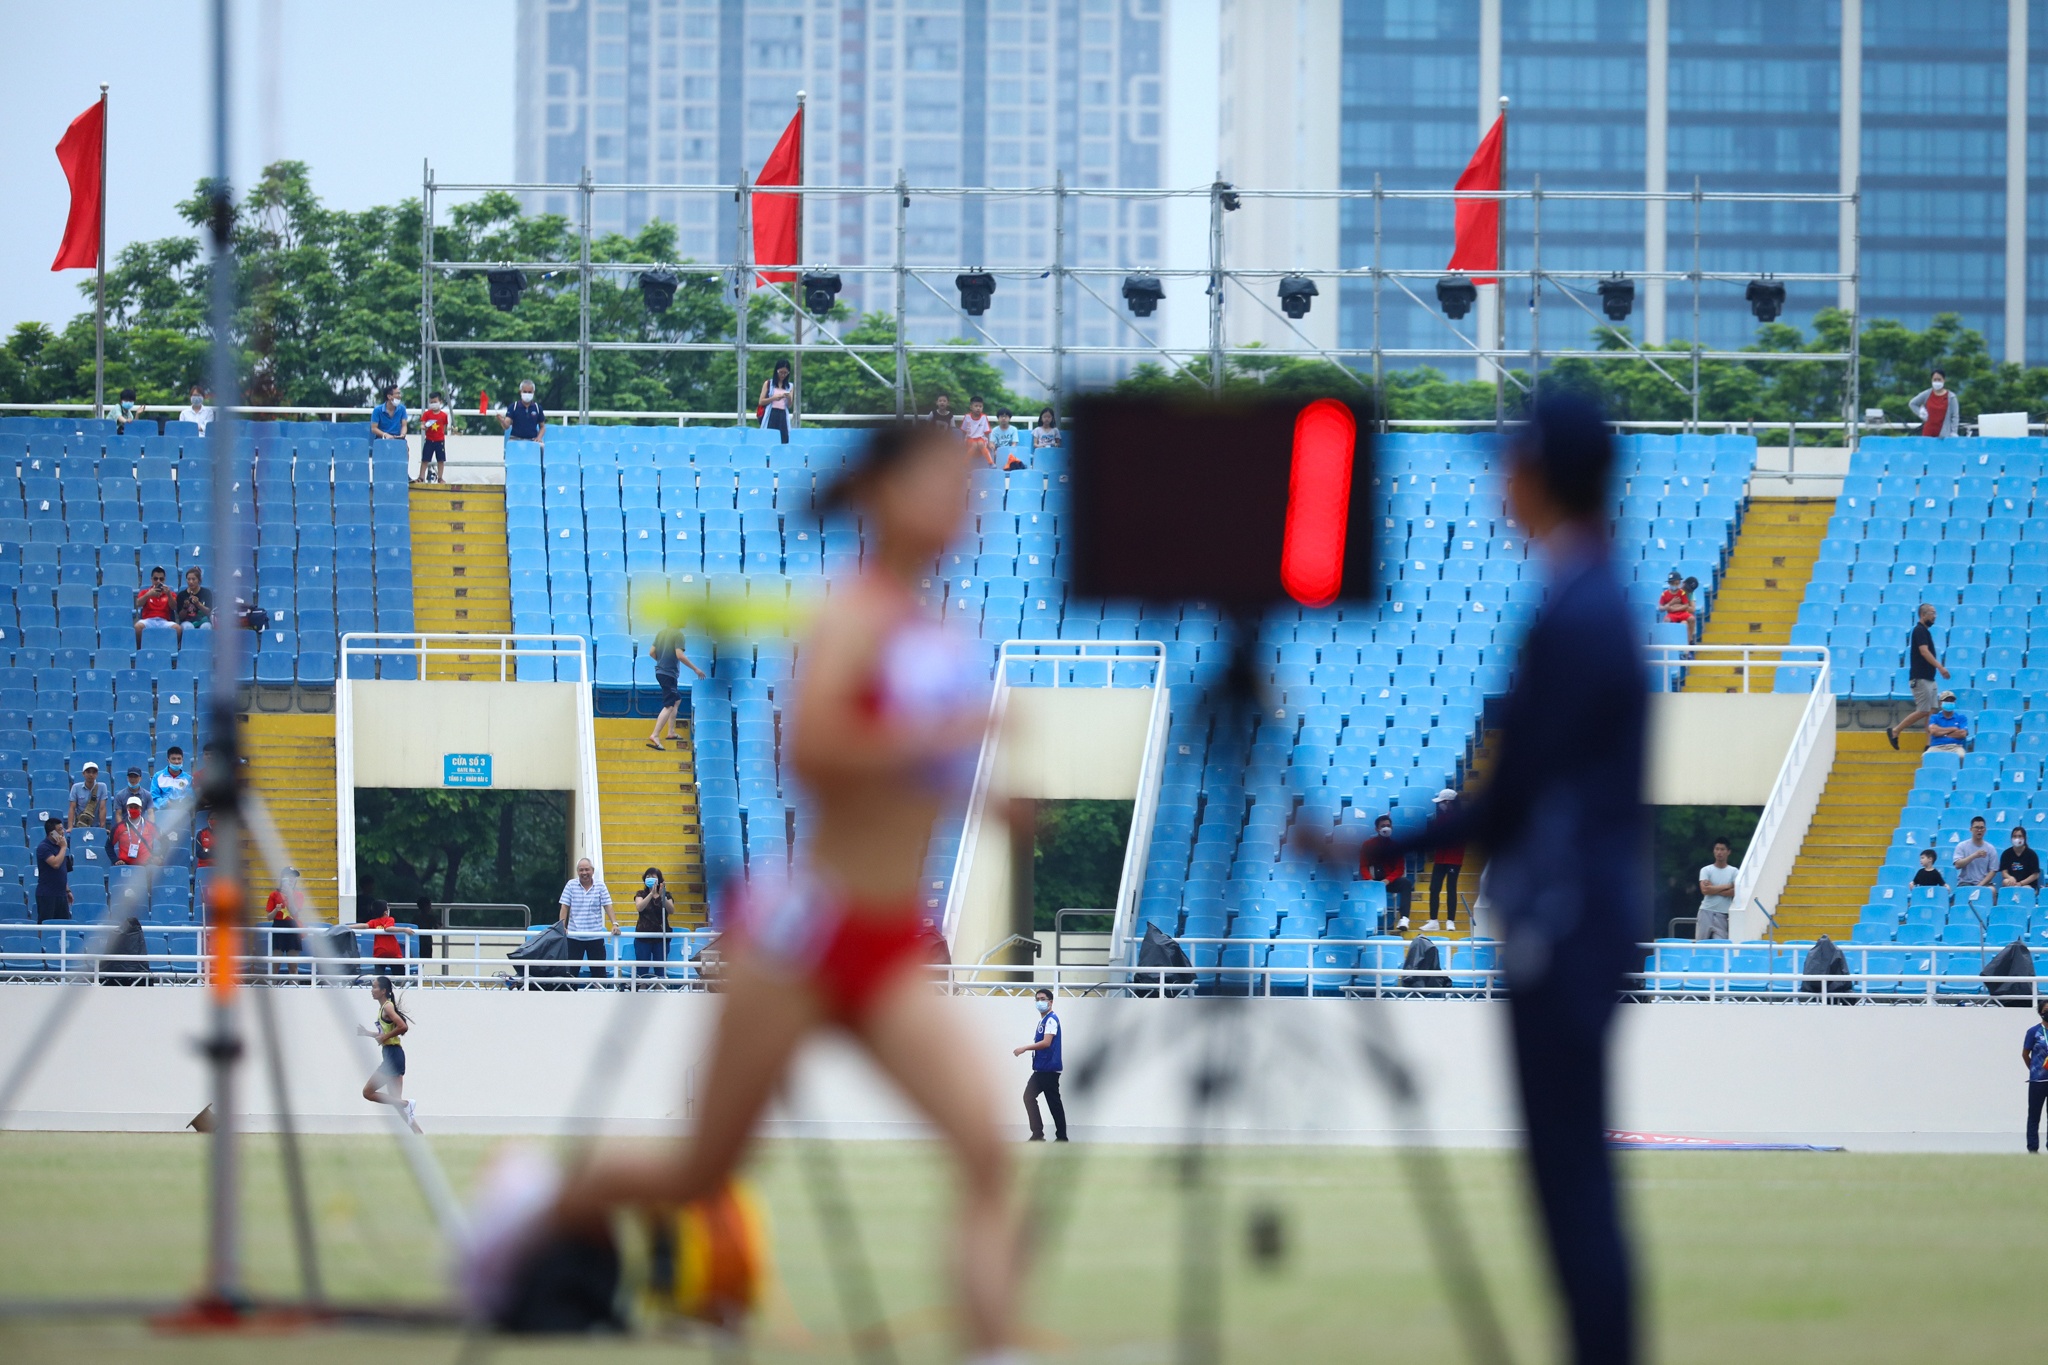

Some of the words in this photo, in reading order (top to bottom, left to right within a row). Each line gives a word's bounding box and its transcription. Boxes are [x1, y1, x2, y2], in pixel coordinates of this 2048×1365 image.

[452, 755, 467, 766] CỬA
[469, 756, 479, 766] SỐ
[480, 758, 485, 766] 3
